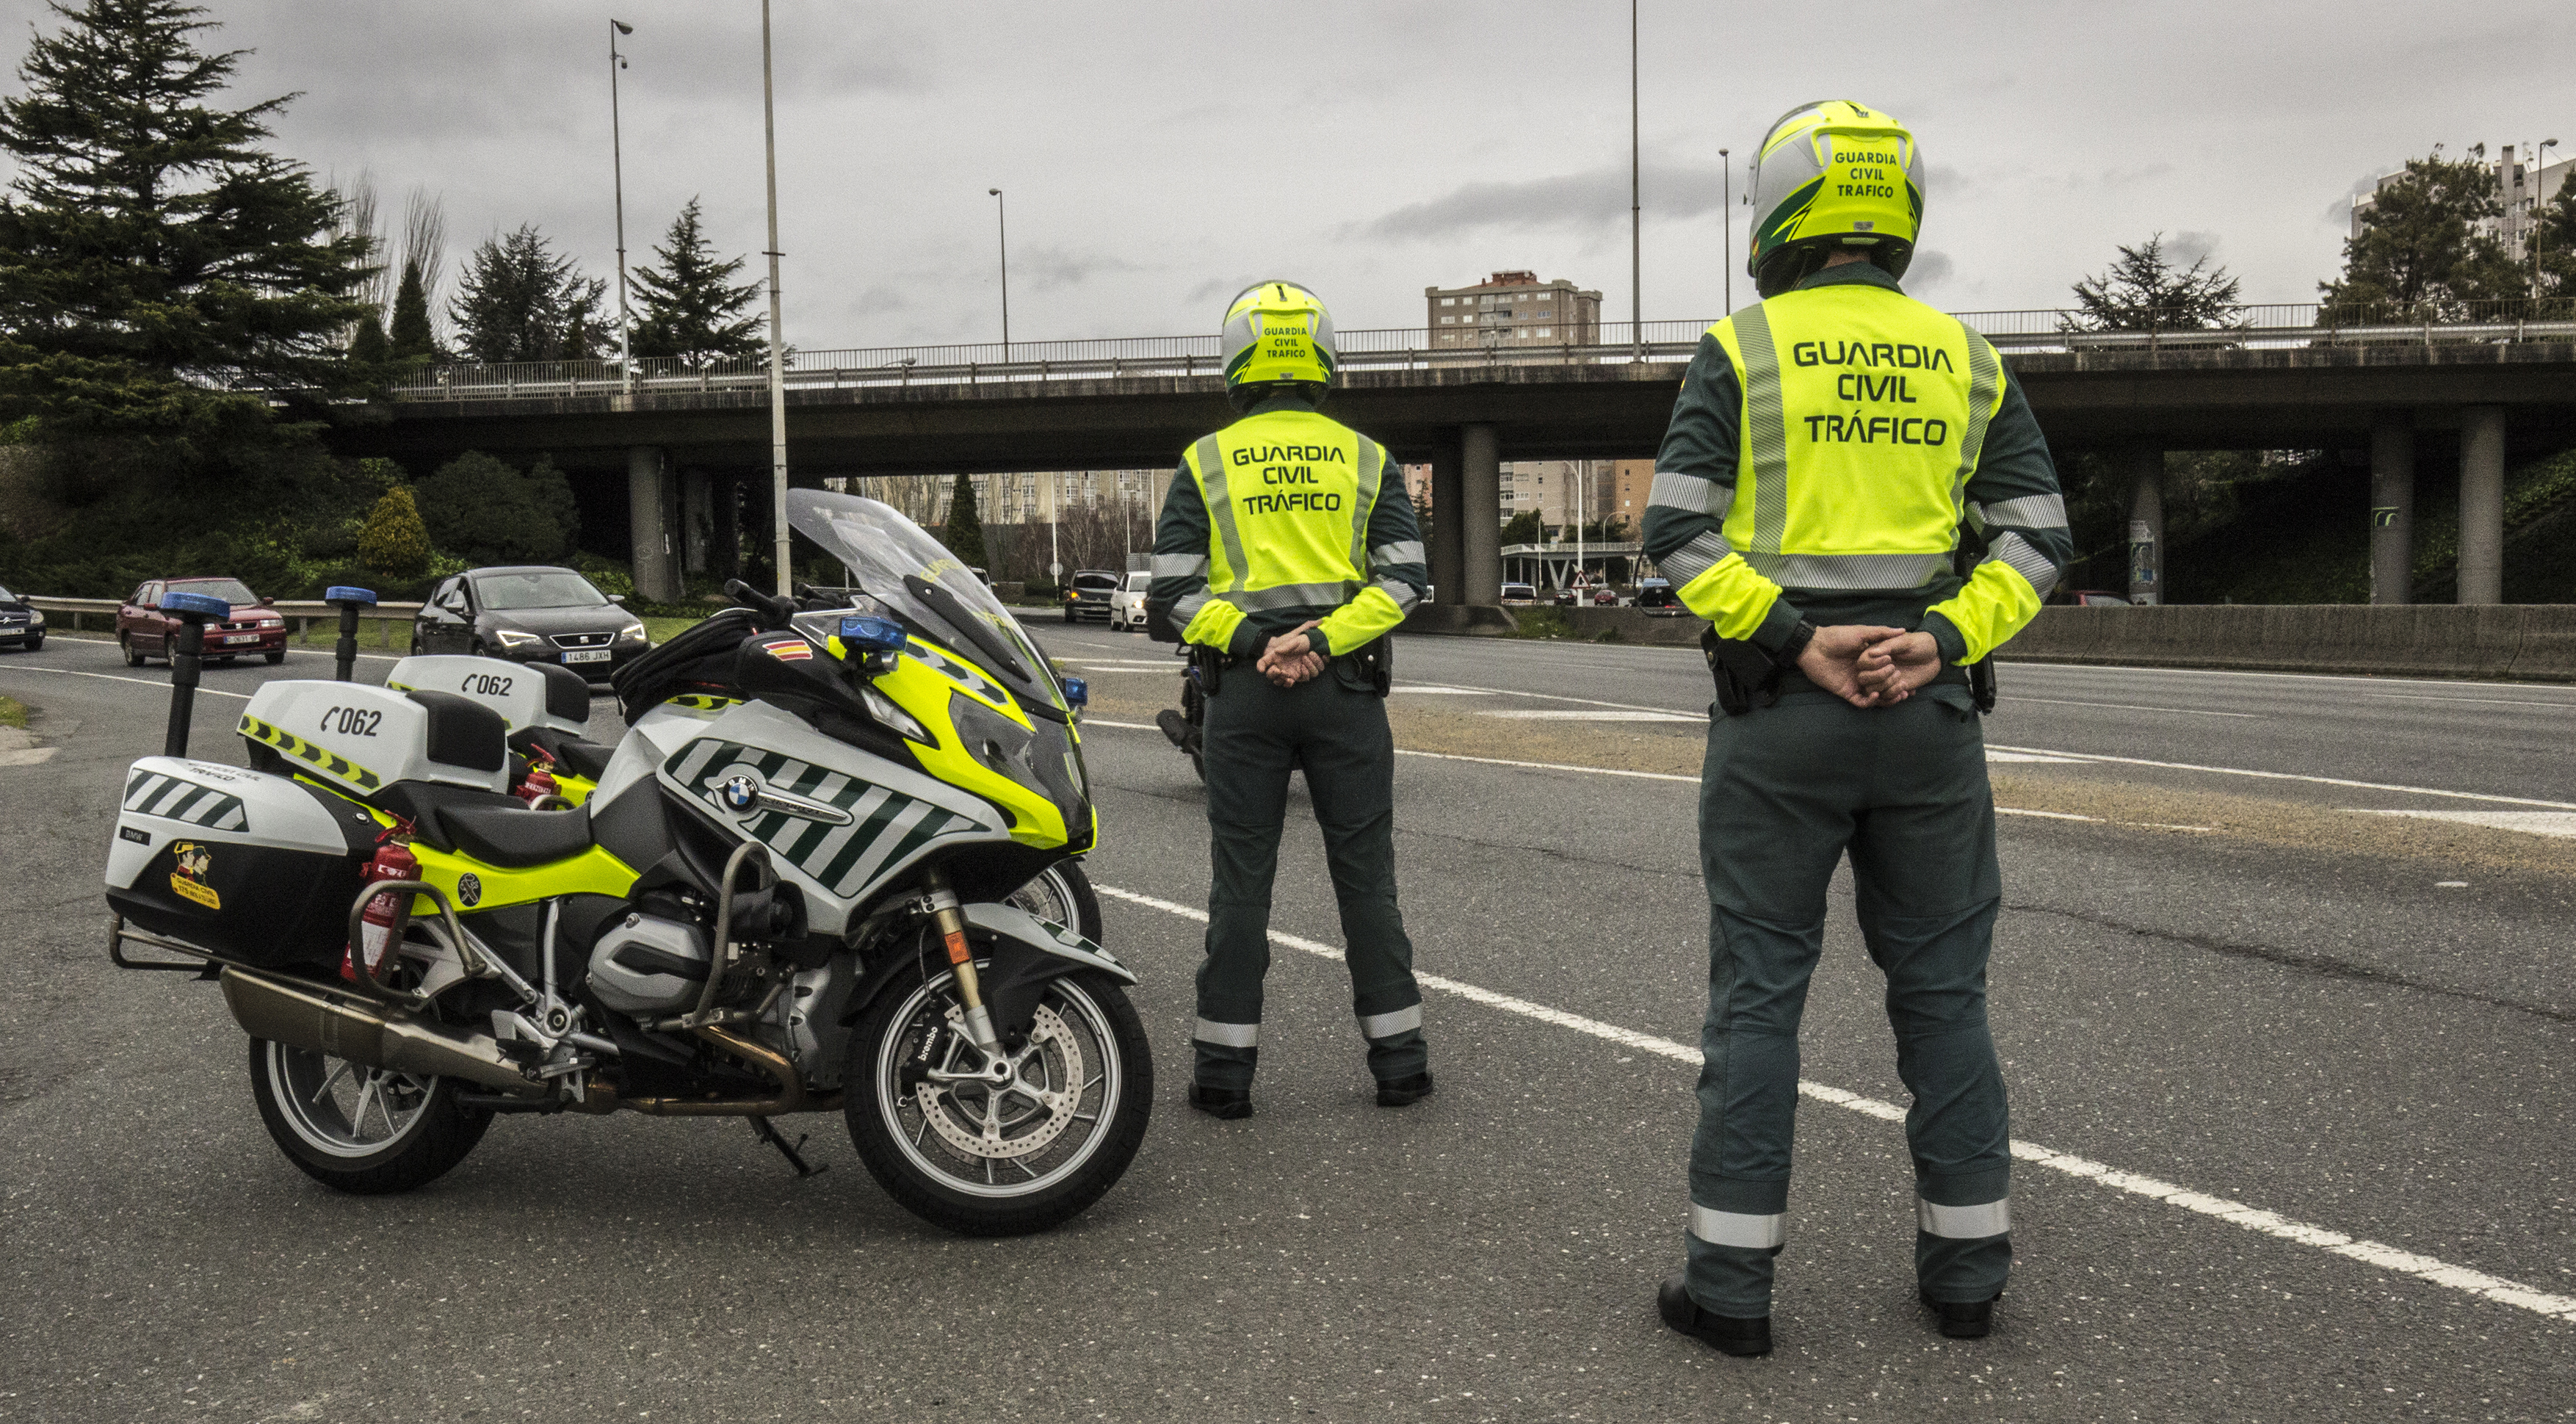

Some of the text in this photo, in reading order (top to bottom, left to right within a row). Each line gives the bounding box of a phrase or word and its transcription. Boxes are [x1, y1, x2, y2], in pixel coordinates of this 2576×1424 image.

[1834, 151, 1897, 165] GUARDIA
[1850, 168, 1884, 181] CIVIL
[1837, 184, 1894, 198] TRAFICO
[1264, 327, 1307, 336] GUARDIA
[1274, 338, 1298, 347] CIVIL
[1267, 350, 1306, 358] TRAFICO
[1792, 341, 1955, 375] GUARDIA
[1837, 373, 1917, 404] CIVIL
[1804, 409, 1947, 447] TRÁFICO
[1232, 445, 1346, 466] GUARDIA
[1263, 466, 1319, 485] CIVIL
[1243, 489, 1341, 516] TRÁFICO
[568, 651, 609, 661] 1486 JXH
[477, 674, 513, 697] 062
[338, 706, 383, 737] 062
[125, 828, 143, 841] BMW
[917, 1027, 938, 1061] brembo
